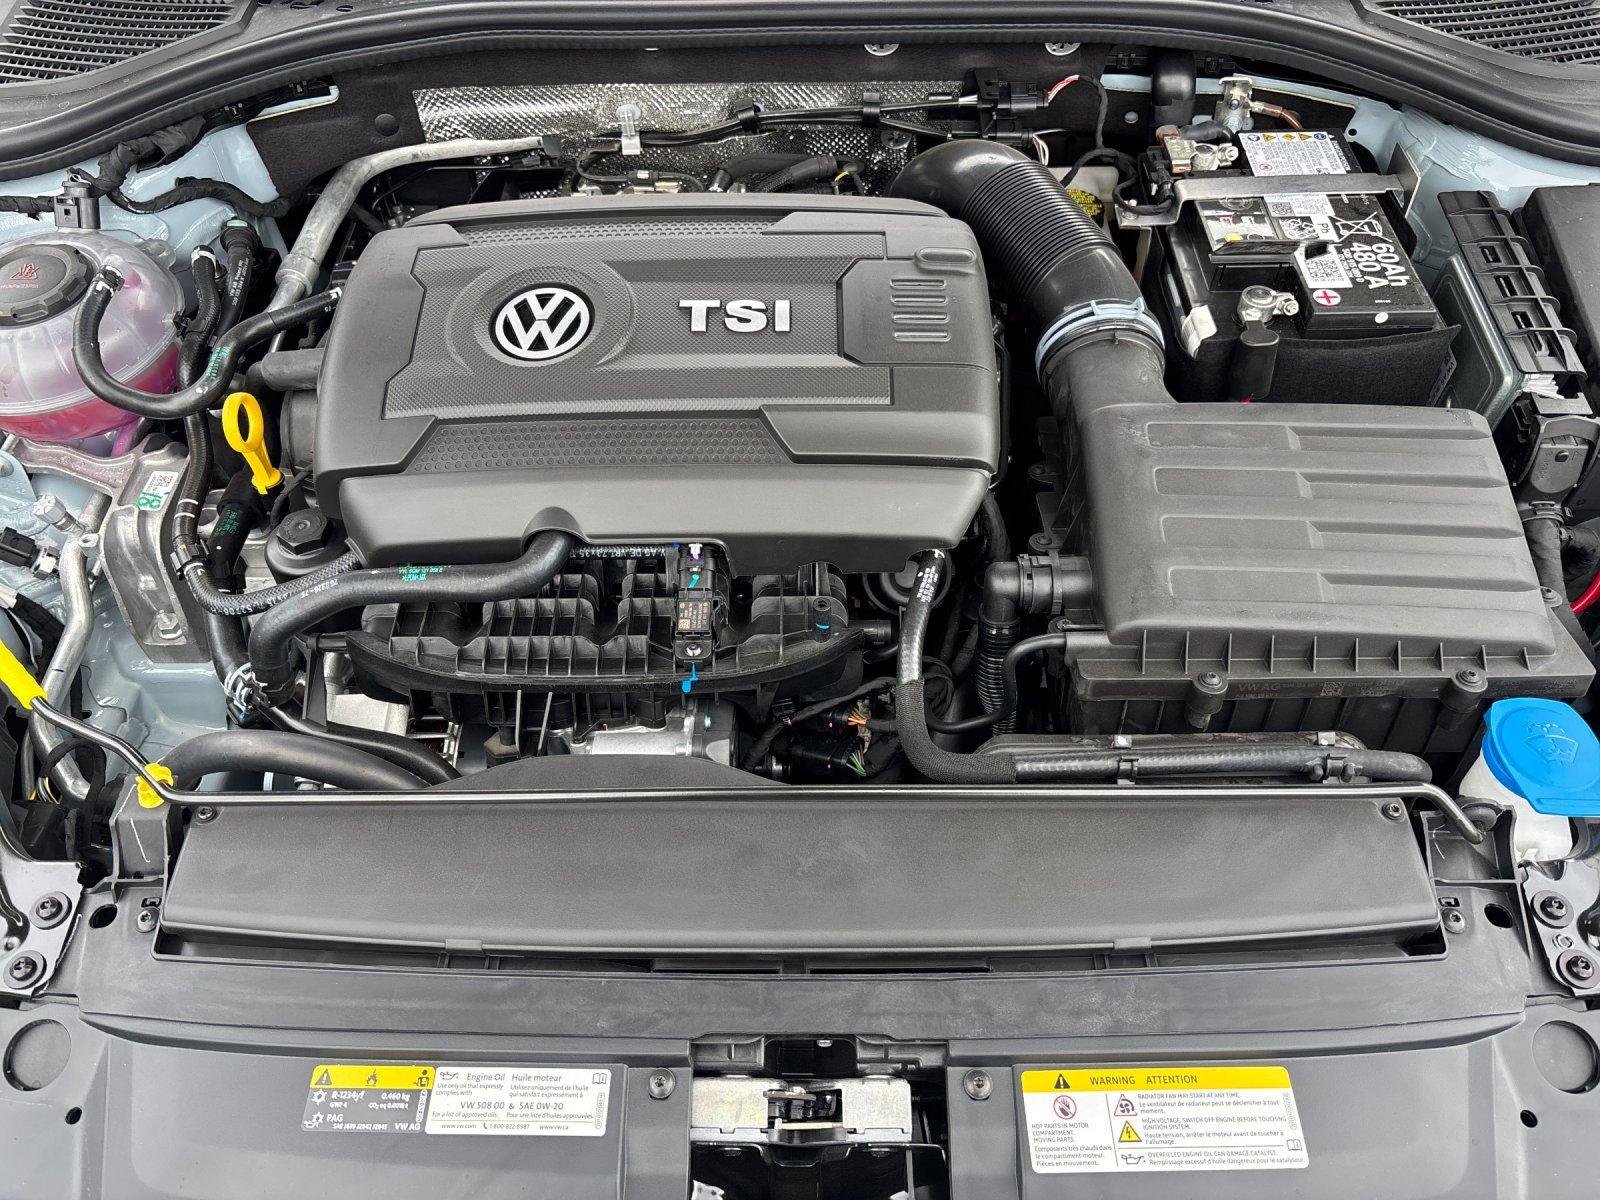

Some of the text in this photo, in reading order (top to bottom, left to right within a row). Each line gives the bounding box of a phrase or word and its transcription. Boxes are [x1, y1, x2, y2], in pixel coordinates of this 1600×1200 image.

[1322, 224, 1330, 234] Pb
[1350, 242, 1382, 272] 480
[1372, 243, 1410, 286] 60Ah
[1364, 276, 1389, 289] A
[678, 300, 790, 332] TSI
[495, 288, 590, 359] VW
[467, 1073, 493, 1082] Engine
[494, 1073, 506, 1081] Oil
[512, 1073, 532, 1081] Huile
[1089, 1075, 1198, 1085] WARNING ATTENTION
[332, 1091, 366, 1102] R-1234yf
[402, 1092, 410, 1102] kg
[461, 1101, 475, 1109] VW
[477, 1101, 492, 1109] 508
[494, 1101, 505, 1109] 00
[519, 1102, 534, 1110] SAE
[536, 1102, 564, 1110] 0W-20
[326, 1114, 344, 1122] PAG
